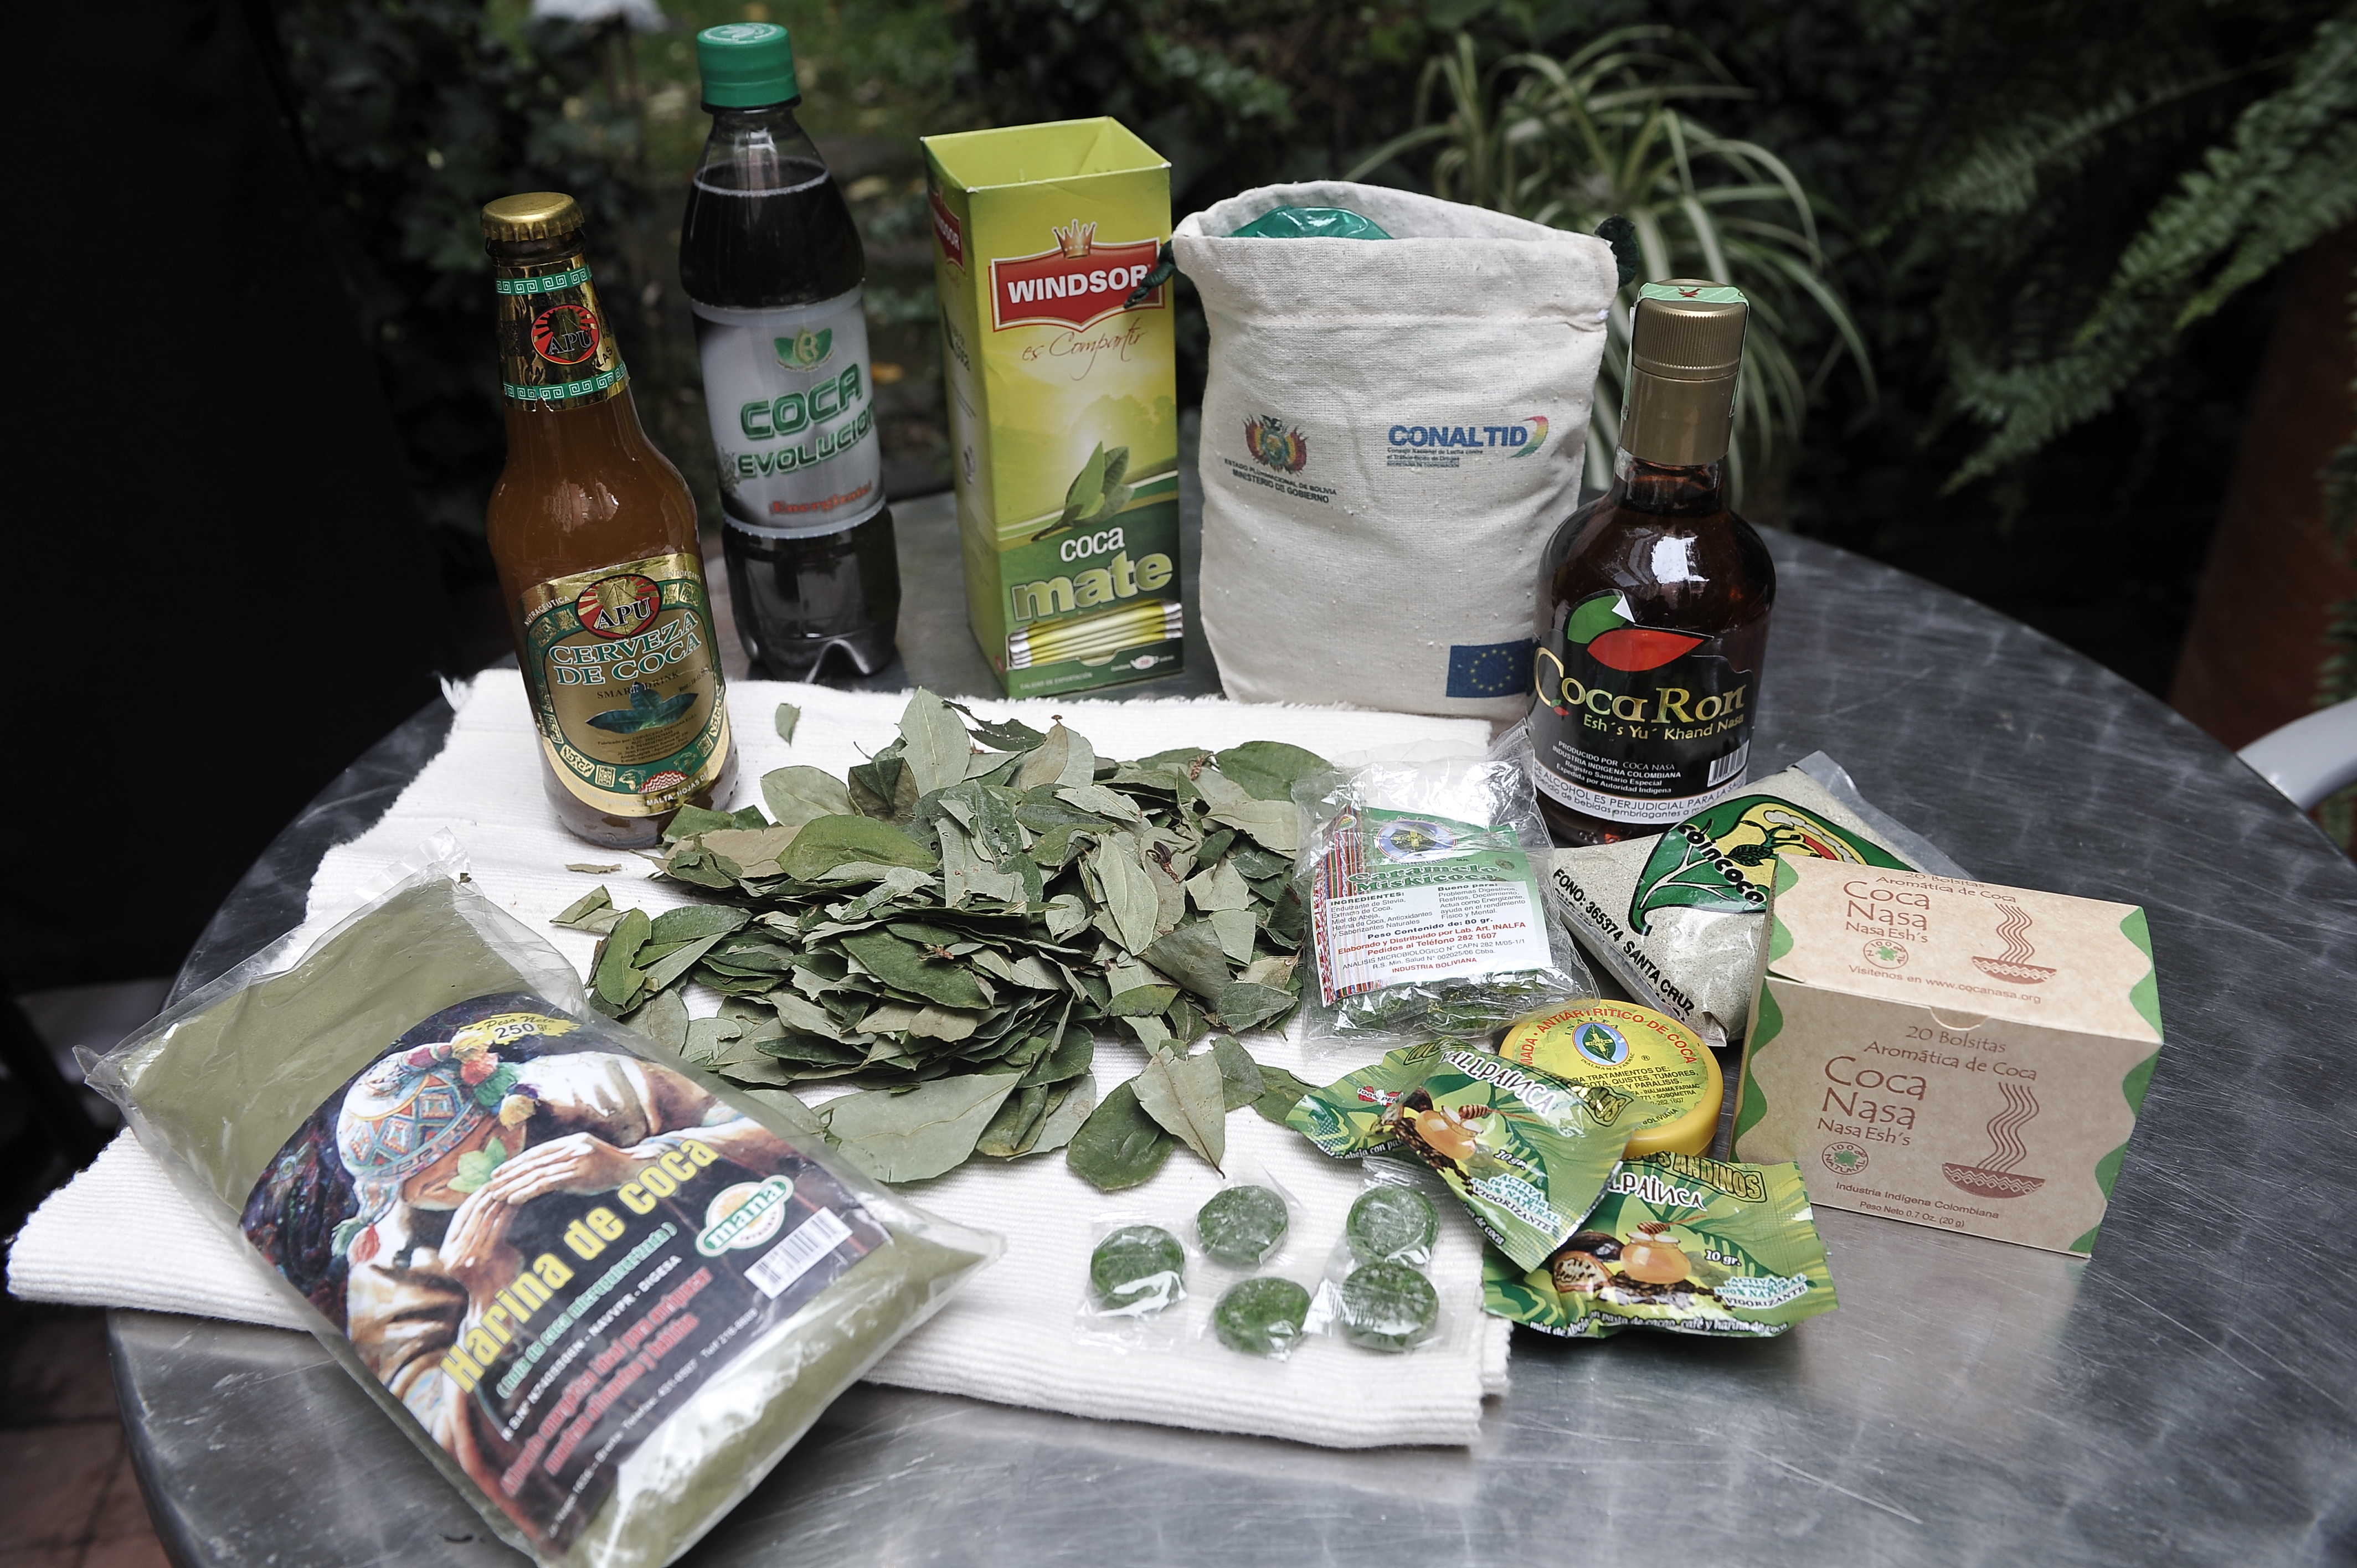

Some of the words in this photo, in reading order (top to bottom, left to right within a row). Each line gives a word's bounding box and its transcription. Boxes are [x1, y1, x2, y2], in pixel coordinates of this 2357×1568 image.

[1007, 265, 1149, 303] WINDSOR
[548, 329, 593, 355] APU
[1049, 318, 1147, 381] Compartir
[740, 363, 863, 440] COCA
[1389, 425, 1527, 447] CONALTID
[1224, 459, 1248, 471] ESTADO
[1310, 486, 1337, 495] BOLIVIA
[1233, 469, 1274, 488] MINISTERIO
[1275, 483, 1285, 492] DE
[1287, 487, 1329, 503] GOBIERNO
[1060, 527, 1125, 562] coca
[1011, 550, 1173, 621] mate
[524, 595, 571, 627] NUTRACEUTICA
[595, 598, 652, 630] APU
[549, 611, 698, 665] CERVEZA
[554, 666, 606, 686] DE
[611, 633, 701, 682] COCA
[645, 670, 680, 691] DRINK
[1534, 647, 1648, 723] Coca
[1650, 684, 1747, 724] Ron
[1664, 724, 1712, 741] Khand
[1716, 714, 1744, 733] Nasa
[1552, 745, 1587, 768] INDUSTRIA
[1588, 761, 1625, 776] INDIGENA
[1627, 770, 1681, 778] COLOMBIANA
[1558, 740, 1599, 762] PRODUCIDO
[1601, 757, 1618, 767] POR
[1623, 761, 1649, 770] COCA
[677, 778, 700, 796] HOJAS
[1556, 763, 1585, 781] Expedida
[1586, 777, 1599, 785] por
[1600, 781, 1637, 792] Autoridad
[1565, 760, 1593, 776] Registro
[1594, 771, 1628, 784] Sanitario
[1629, 778, 1663, 787] Especial
[1545, 772, 1591, 801] ALCOHOL
[1594, 795, 1606, 805] ES
[1610, 798, 1684, 811] PERJUDICIAL
[1687, 793, 1715, 808] PARA
[1562, 791, 1572, 801] de
[1574, 795, 1611, 814] bebidas
[1348, 864, 1500, 883] Caramelo
[1355, 873, 1495, 893] Miskicoca
[1932, 875, 1985, 888] Bolsitas
[1331, 892, 1404, 906] INGREDIENTES:
[1843, 880, 1931, 910] Coca
[1876, 876, 1954, 893] Aromática
[1958, 887, 1975, 896] de
[1980, 890, 2016, 903] Coca
[1845, 921, 1885, 938] Nasa
[1846, 900, 1928, 931] Nasa
[1339, 942, 1381, 955] Elaborado
[1390, 932, 1436, 945] Distribuido
[1493, 922, 1526, 930] INALFA
[1368, 946, 1403, 956] Pedidos
[1416, 936, 1455, 947] Teléfono
[1553, 868, 1587, 906] FONO:
[1584, 901, 1624, 942] 365374
[1623, 938, 1661, 985] SANTA
[1660, 978, 1695, 1017] CRUZ
[1342, 958, 1376, 970] ANALISIS
[1377, 947, 1445, 962] MICROBIOLOGICO
[1392, 964, 1434, 973] INDUSTRIA
[1435, 957, 1477, 968] BOLIVIANA
[1849, 964, 1903, 981] Visitenos
[1907, 974, 1922, 984] en
[1926, 977, 2041, 1004] www.cocanasa.org
[484, 1019, 517, 1030] Peso
[495, 1023, 534, 1039] 250
[1565, 1017, 1619, 1036] INALFA
[1646, 1020, 1670, 1034] DE
[1667, 1034, 1698, 1064] COCA
[1905, 1025, 1933, 1041] 20
[1939, 1030, 2006, 1053] Bolsitas
[1581, 1058, 1618, 1071] INALMAMA
[1619, 1052, 1635, 1070] FARMAC
[1586, 1068, 1654, 1081] TRATAMIENTOS
[1864, 1040, 1959, 1069] Aromática
[1965, 1057, 1987, 1074] de
[1993, 1061, 2037, 1081] Coca
[1612, 1075, 1653, 1085] QUISTES,
[1654, 1070, 1699, 1080] TUMORES,
[1635, 1078, 1682, 1089] PARALISIS.
[1825, 1056, 1928, 1101] Coca
[1821, 1087, 1916, 1131] Nasa
[1817, 1117, 1861, 1138] Nasa
[1494, 1150, 1512, 1160] 10
[1824, 1154, 1866, 1174] NATURAL
[1499, 1174, 1542, 1201] ACTIVA
[1672, 1153, 1763, 1199] ANDINOS
[1475, 1186, 1551, 1231] VIGORIZANTE
[1836, 1182, 1882, 1198] Industria
[1885, 1191, 1932, 1208] Indígena
[1934, 1201, 1999, 1219] Colombiana
[1860, 1200, 1882, 1212] Peso
[1883, 1205, 1904, 1216] Neto
[1906, 1209, 1920, 1219] 0.7
[1922, 1213, 1937, 1223] Oz.
[1939, 1216, 1954, 1226] (20
[1955, 1219, 1965, 1229] g)
[439, 1249, 575, 1394] Harina
[563, 1206, 626, 1263] de
[616, 1138, 720, 1216] coca
[1705, 1250, 1721, 1261] 10
[1723, 1256, 1742, 1267] gr.
[1725, 1285, 1806, 1307] VIGORIZANTE
[1731, 1277, 1777, 1287] ACTIVA
